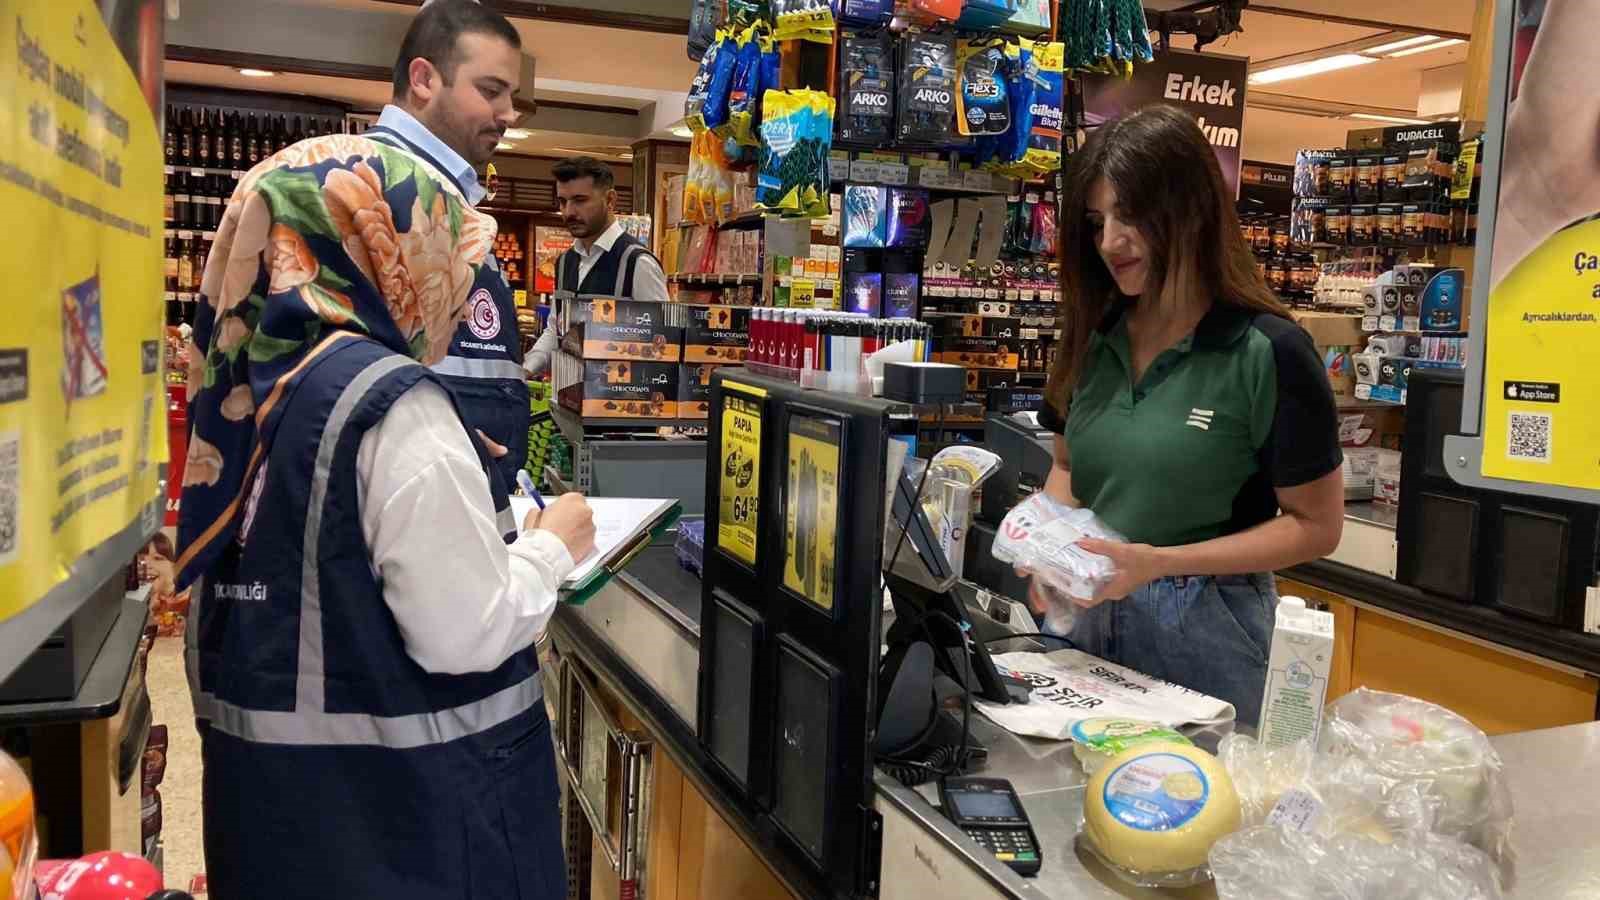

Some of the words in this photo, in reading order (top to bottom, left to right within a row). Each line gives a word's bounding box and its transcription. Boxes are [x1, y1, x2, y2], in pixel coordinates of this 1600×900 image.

[914, 88, 951, 104] ARKO
[1163, 72, 1236, 107] Erkek
[852, 92, 889, 106] ARKO
[1197, 116, 1239, 148] kım
[1396, 128, 1444, 142] DURACELL
[1574, 251, 1600, 276] Ça
[1523, 311, 1596, 323] Ayrıcalıklardan,
[1520, 390, 1536, 400] App
[1536, 390, 1555, 400] Store
